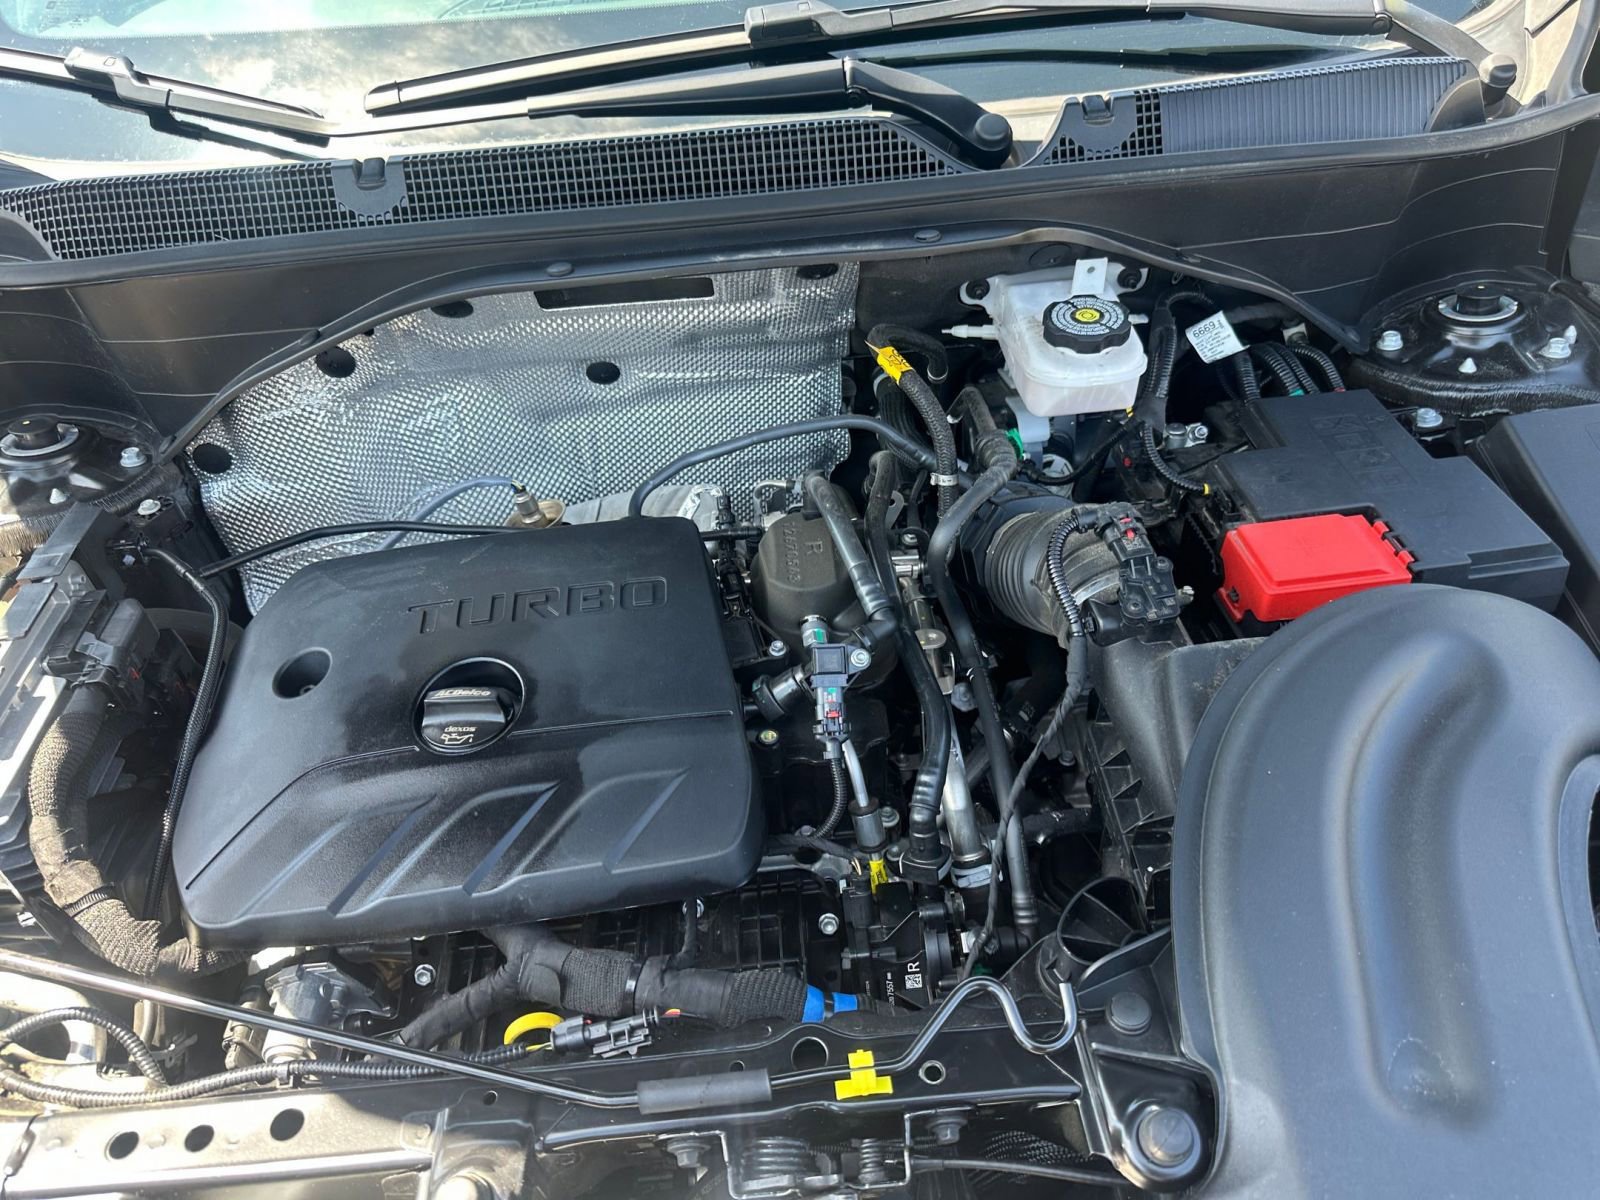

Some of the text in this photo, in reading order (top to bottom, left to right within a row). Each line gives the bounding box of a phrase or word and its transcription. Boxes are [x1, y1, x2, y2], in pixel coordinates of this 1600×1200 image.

[1192, 320, 1216, 338] 6669
[804, 540, 822, 556] R
[408, 576, 667, 634] TURBO
[434, 688, 491, 697] ACDelco
[444, 725, 477, 733] dexos
[907, 961, 920, 972] R
